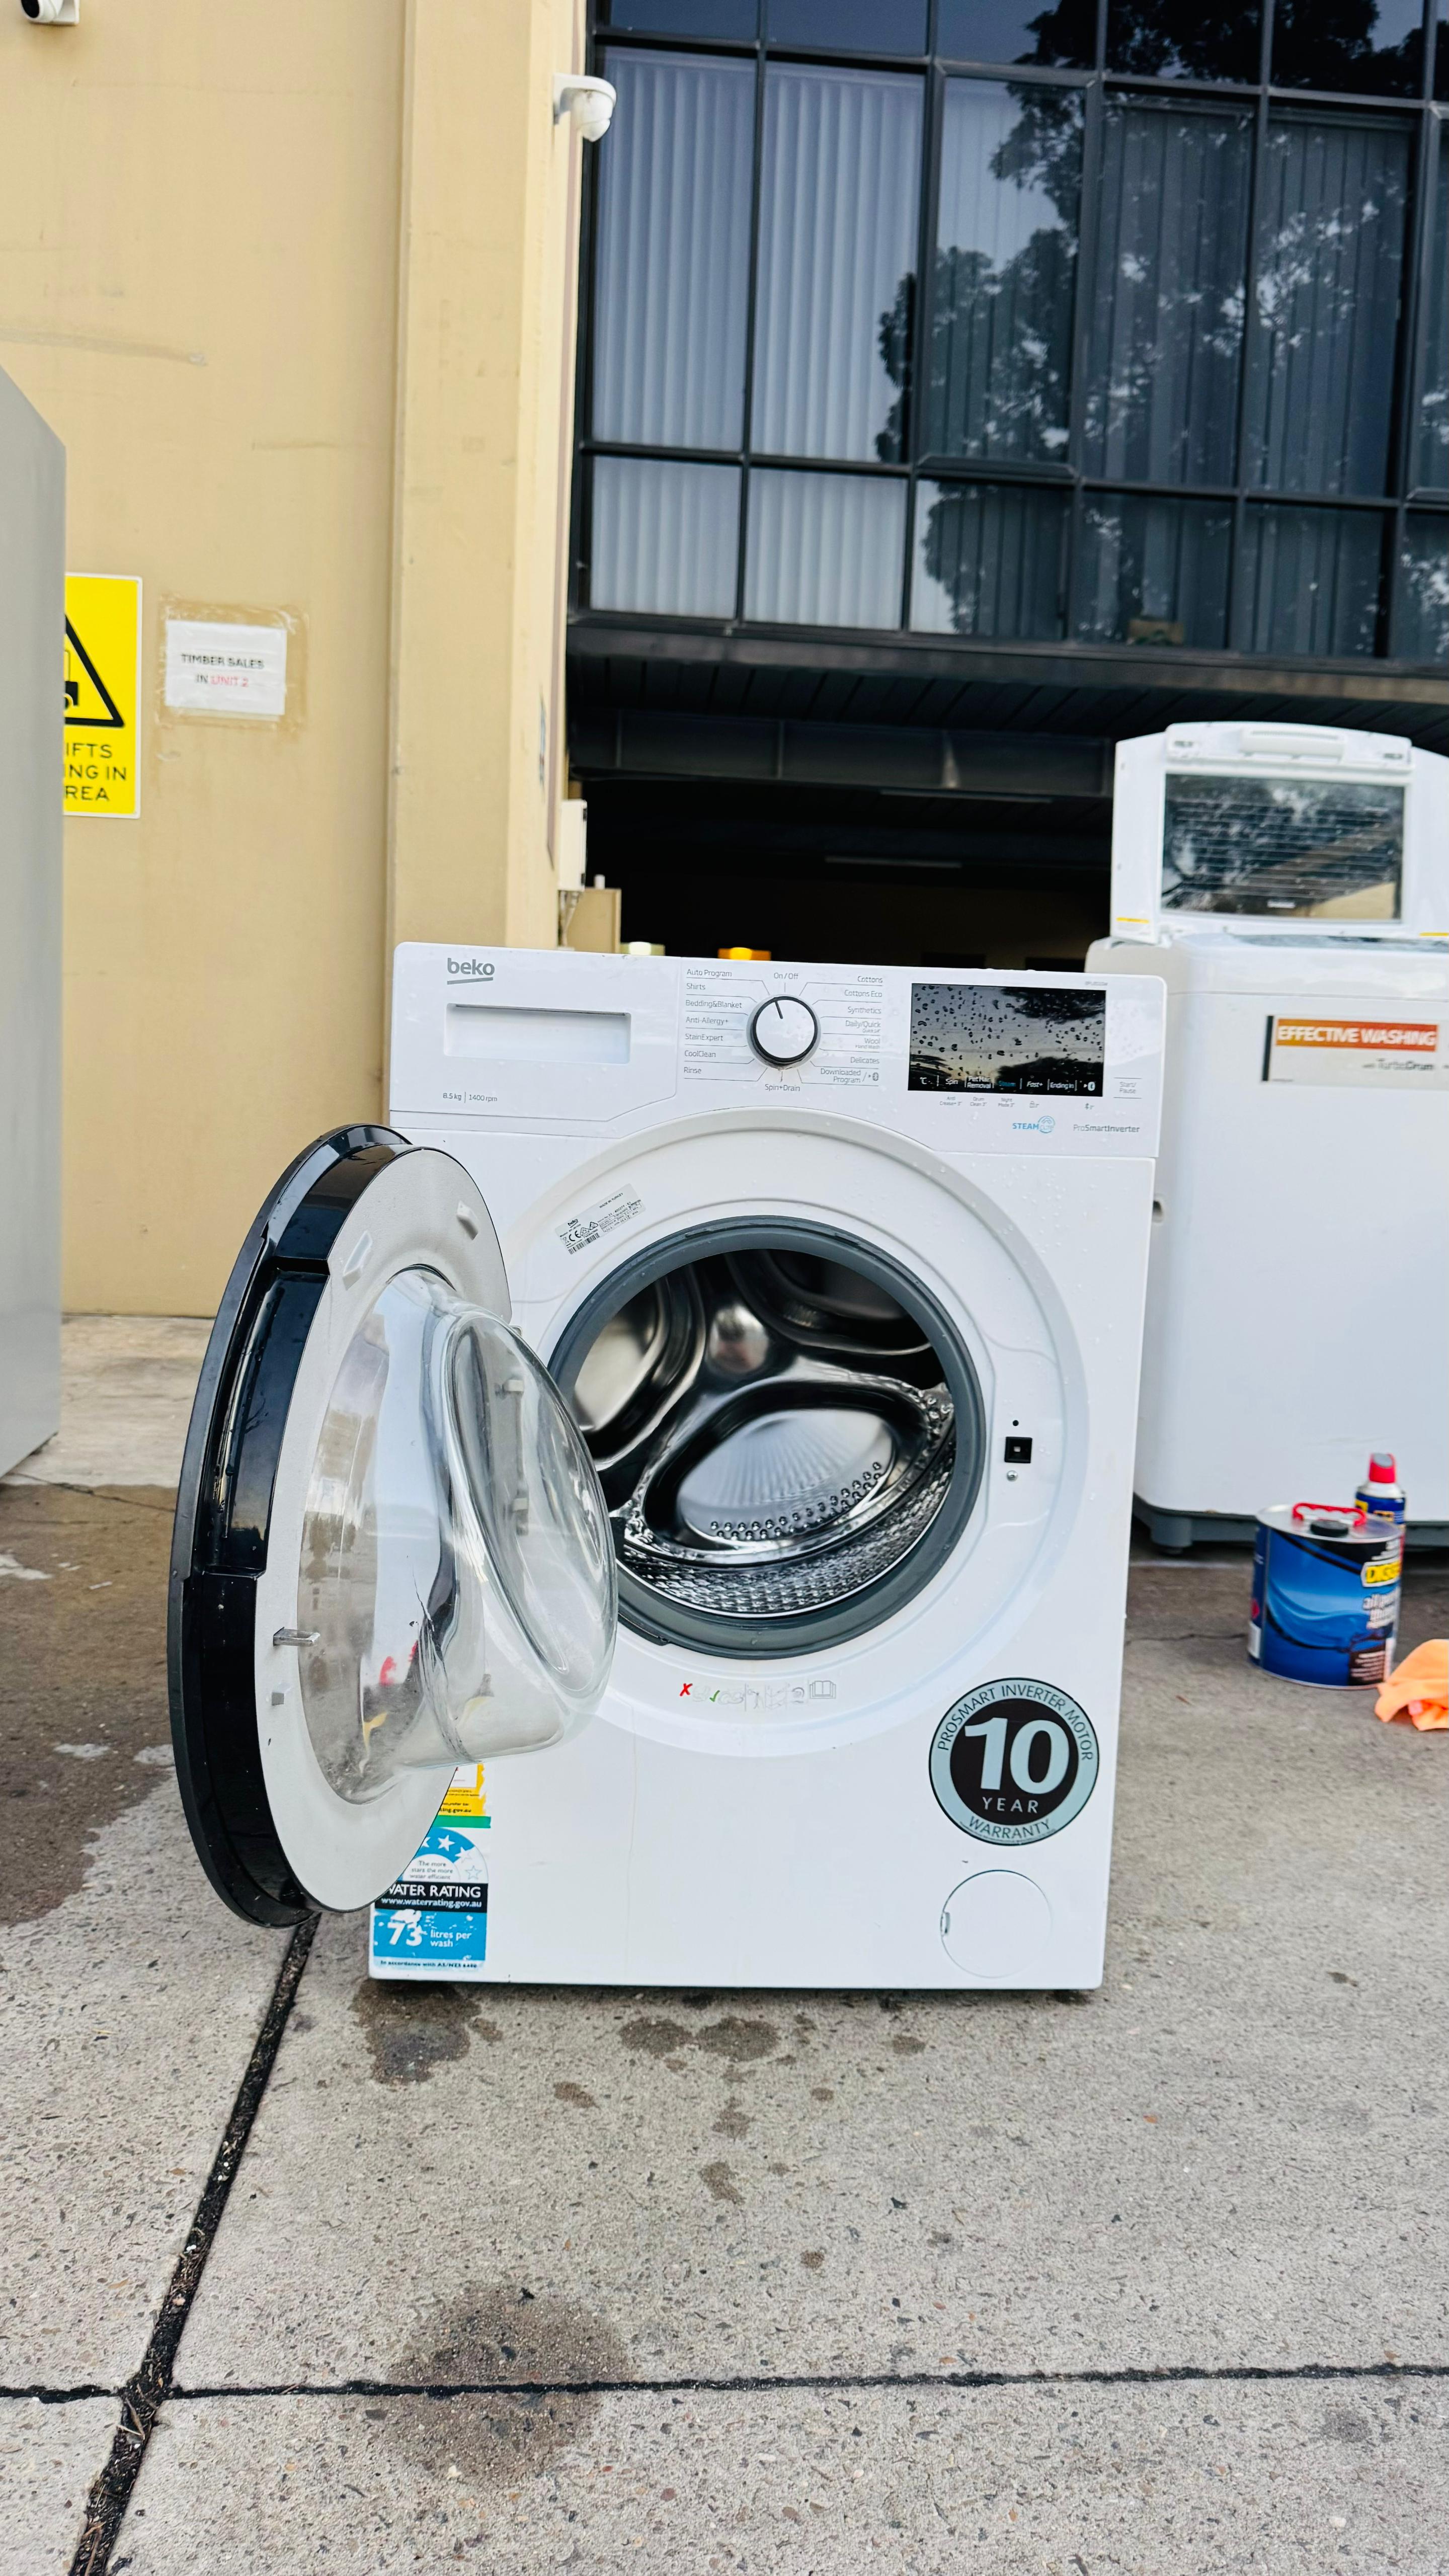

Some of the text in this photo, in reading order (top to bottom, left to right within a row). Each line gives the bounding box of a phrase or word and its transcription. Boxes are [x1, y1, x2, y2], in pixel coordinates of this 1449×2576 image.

[182, 653, 265, 670] TIMBER SALES
[196, 674, 249, 687] IN UNIT 2
[65, 742, 113, 759] IFTS
[106, 766, 126, 781] IN
[65, 785, 110, 801] REA
[447, 957, 495, 976] beko
[704, 970, 732, 978] Program
[685, 999, 742, 1009] Bedding&Blanket
[847, 1006, 881, 1014] Synthetics
[686, 1016, 729, 1025] Anti-Allergy+
[845, 1020, 881, 1029] Daily/Quick
[685, 1033, 723, 1042] StainExpert
[1277, 1025, 1436, 1046] EFFECTIVE WASHING
[821, 1068, 861, 1076] Downloaded
[833, 1076, 861, 1085] Program
[945, 1078, 958, 1086] Spin
[1050, 1082, 1069, 1090] Ending
[454, 1093, 462, 1101] kg
[1073, 1124, 1141, 1133] ProSmartInverter
[1001, 1684, 1067, 1711] INVERTER
[937, 1687, 996, 1751] PROSMART
[1065, 1709, 1094, 1761] MOTOR
[964, 1717, 1070, 1795] 10
[982, 1797, 1039, 1814] YEAR
[969, 1815, 1051, 1839] WARRANTY
[430, 1885, 481, 1898] RATING
[381, 1897, 482, 1909] www.waterrating.gov.au
[387, 1922, 423, 1947] 73
[430, 1929, 472, 1941] litres per
[430, 1939, 453, 1947] wash
